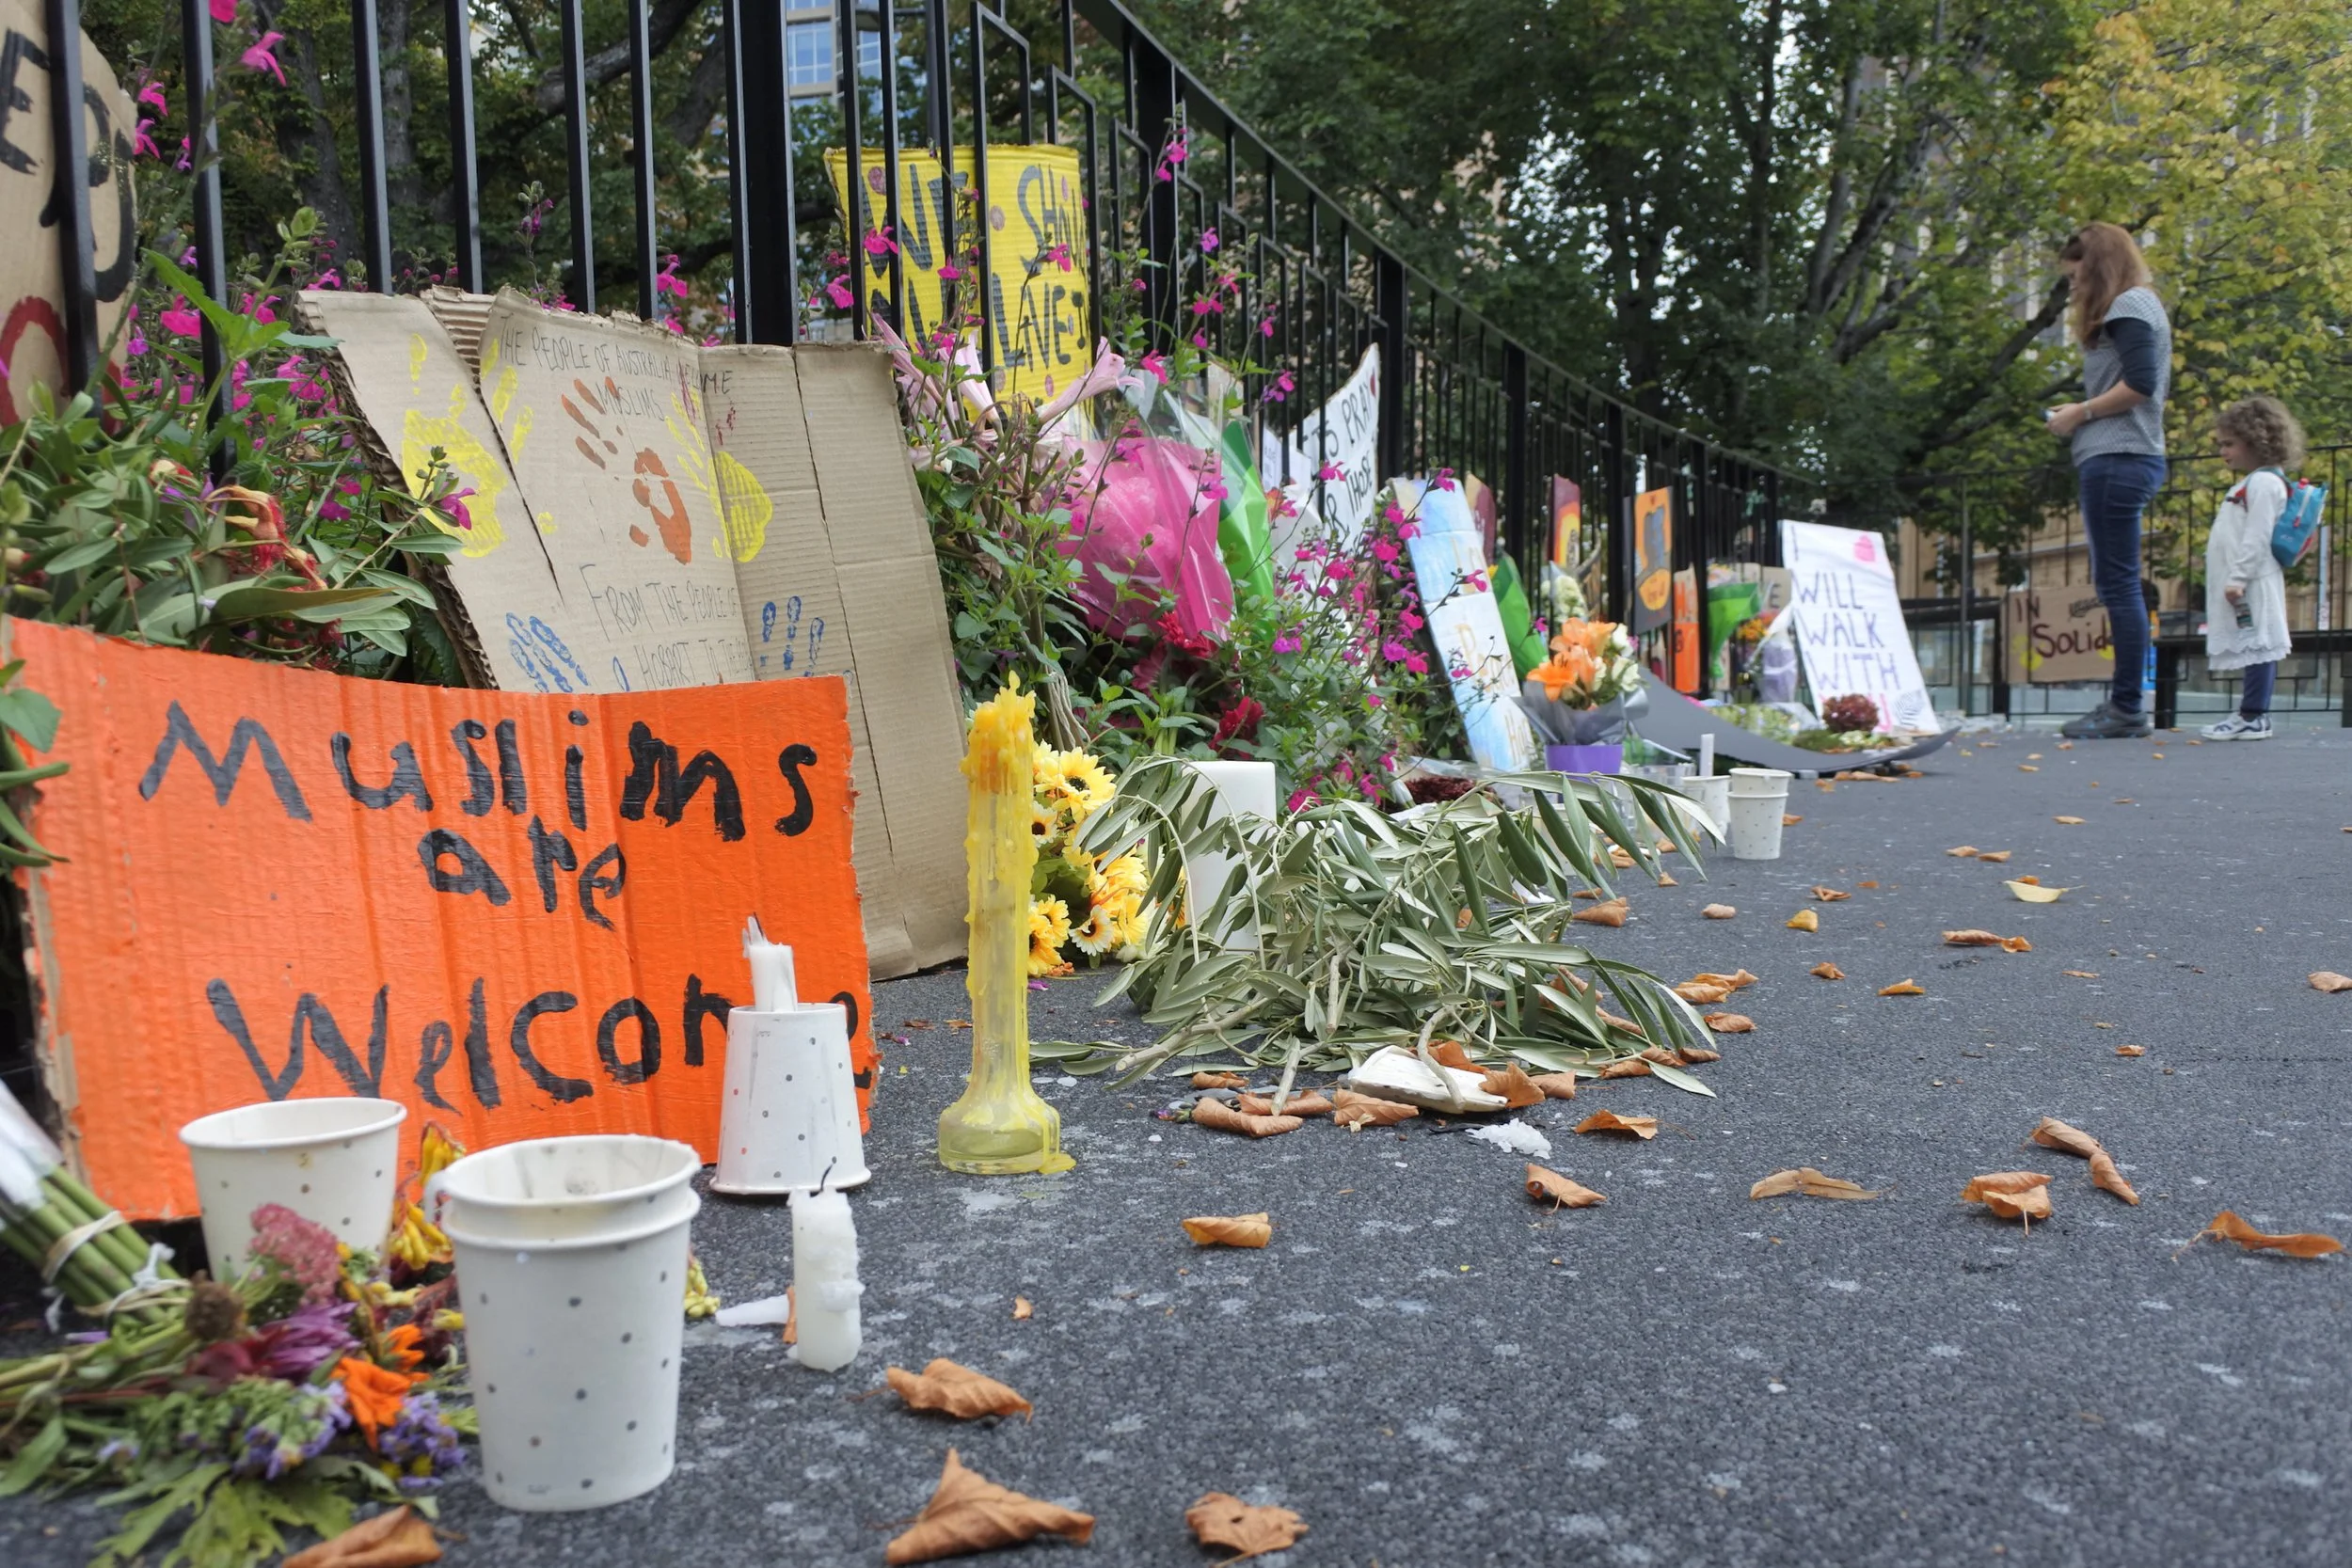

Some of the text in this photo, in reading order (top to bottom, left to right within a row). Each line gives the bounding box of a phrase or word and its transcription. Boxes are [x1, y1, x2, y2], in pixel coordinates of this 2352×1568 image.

[500, 312, 527, 366] THE
[532, 326, 591, 372] PEOPLE
[594, 342, 611, 373] OF
[614, 343, 673, 384] AUSTRALIA
[595, 381, 665, 421] MUSLIMS
[1342, 370, 1373, 445] PRAY
[580, 563, 655, 643] FROM
[645, 582, 689, 627] THE
[686, 579, 727, 624] PEOPLE
[1791, 570, 1864, 610] WILL
[1796, 610, 1885, 647] WALK
[2031, 614, 2113, 658] Solid
[633, 641, 695, 689] HOBART
[1804, 651, 1901, 690] WITH
[137, 700, 818, 843] Muslims
[417, 815, 628, 932] are
[205, 974, 882, 1117] Welco
